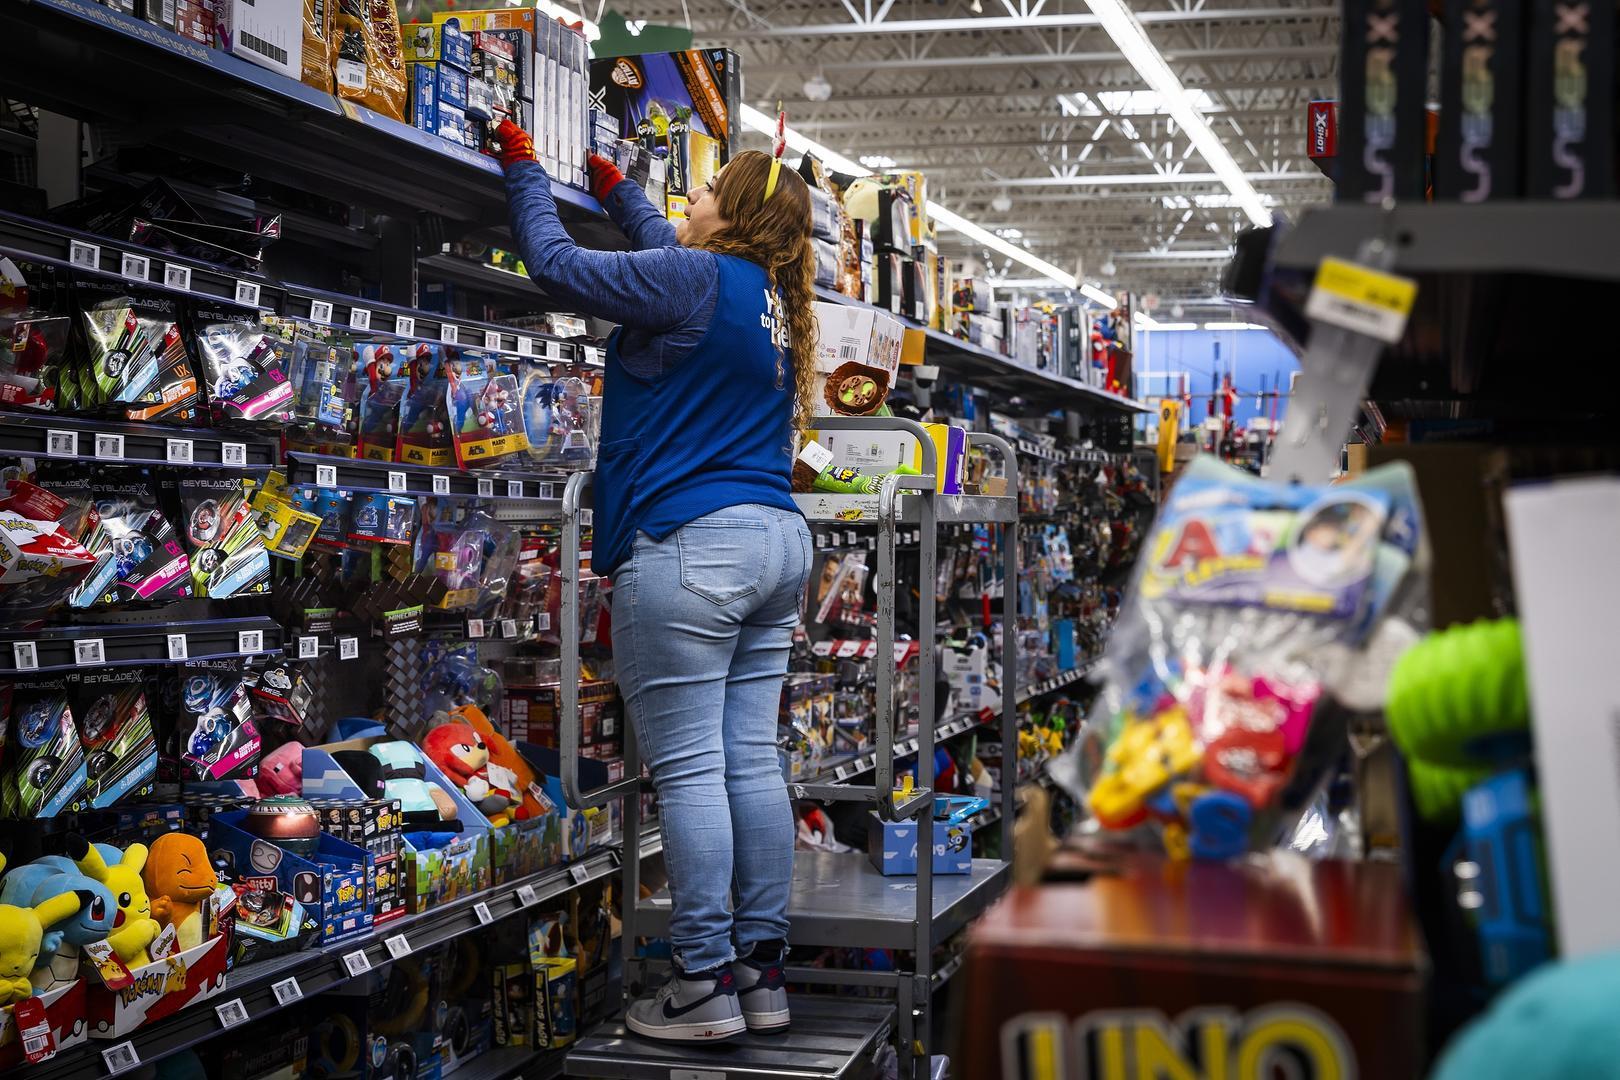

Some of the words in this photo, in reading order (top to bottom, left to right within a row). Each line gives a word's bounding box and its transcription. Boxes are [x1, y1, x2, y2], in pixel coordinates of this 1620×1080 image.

[760, 313, 771, 328] to
[771, 317, 792, 349] Hel
[173, 363, 190, 378] UX
